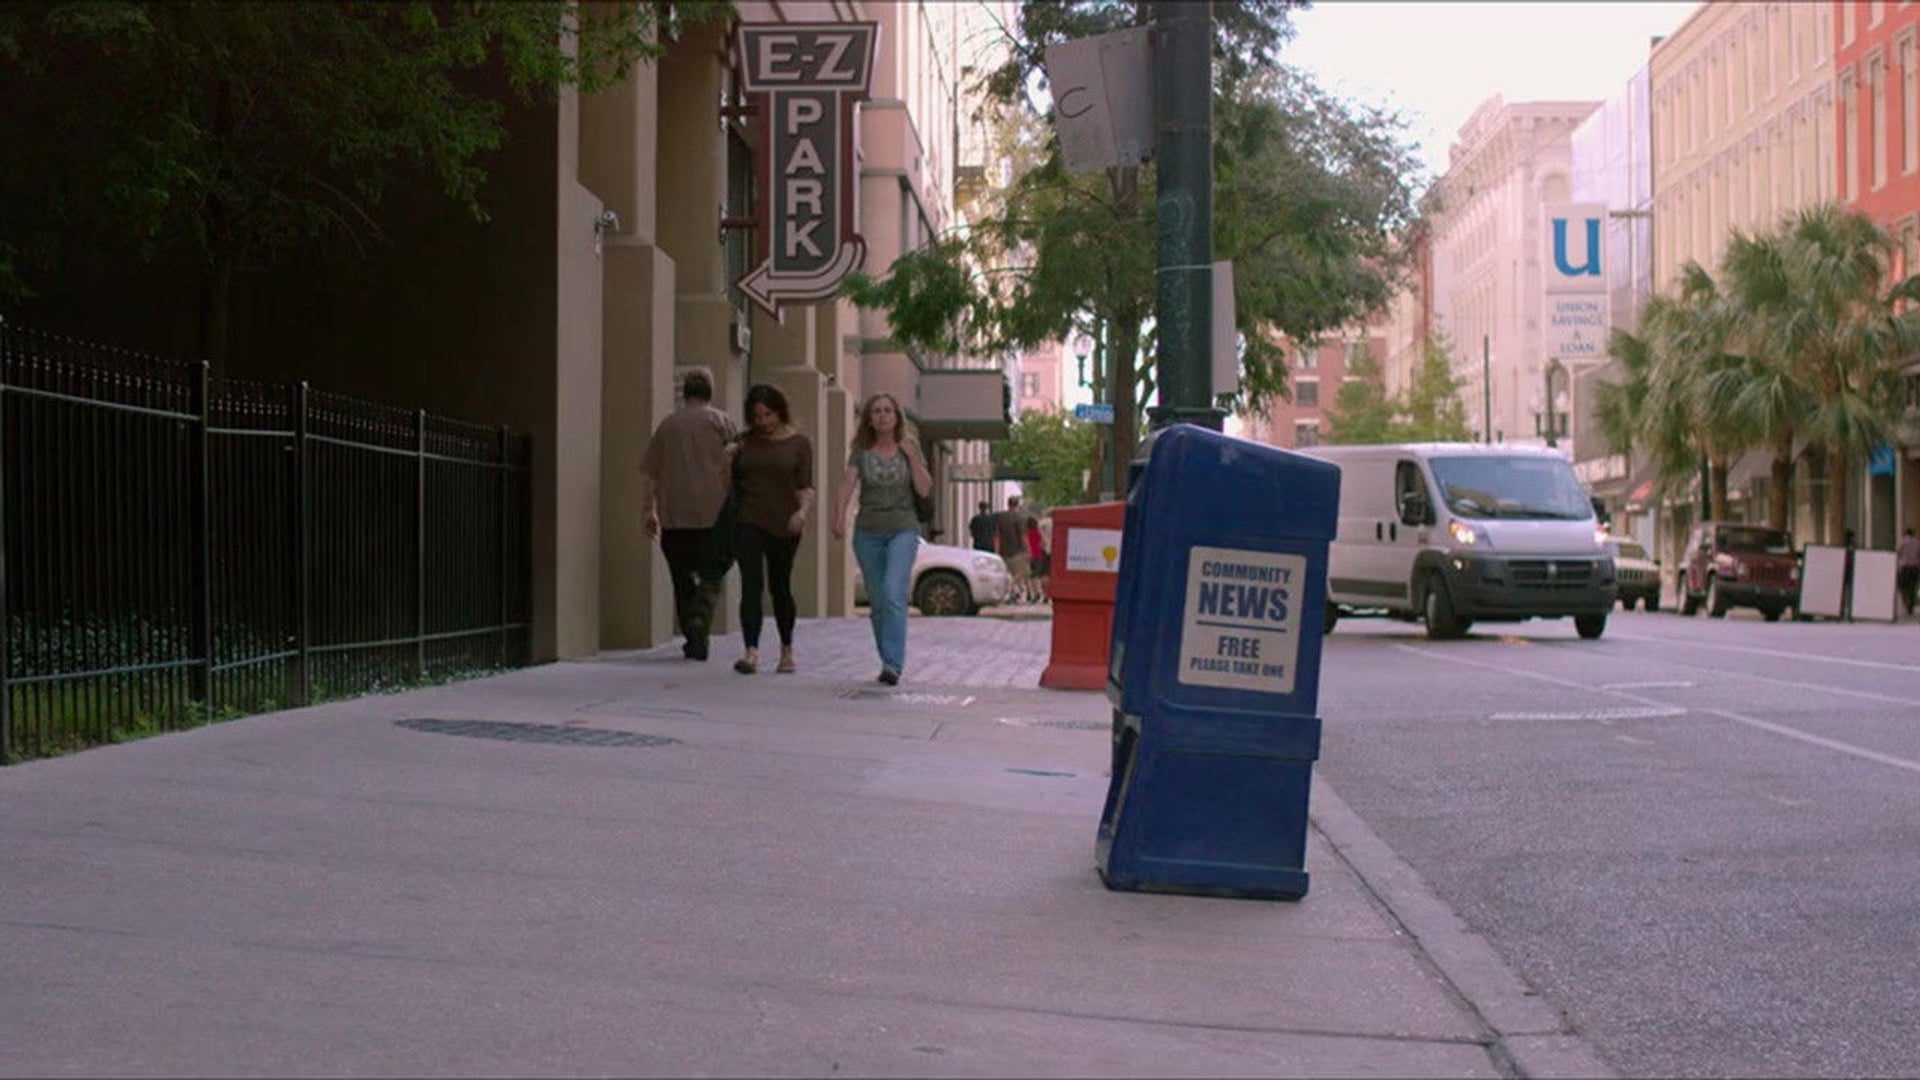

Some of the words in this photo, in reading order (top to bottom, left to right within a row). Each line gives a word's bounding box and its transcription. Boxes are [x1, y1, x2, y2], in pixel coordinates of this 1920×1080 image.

[758, 34, 855, 81] E-Z
[785, 98, 826, 258] PARK
[1556, 302, 1599, 313] UNION
[1552, 316, 1602, 326] SAVINGS
[1560, 344, 1595, 353] LOAN
[1202, 561, 1292, 584] COMMUNITY
[1198, 582, 1288, 622] NEWS
[1217, 636, 1261, 659] FREE
[1190, 657, 1230, 673] PLEASE
[1233, 661, 1260, 676] TAKE
[1262, 664, 1285, 679] ONE
